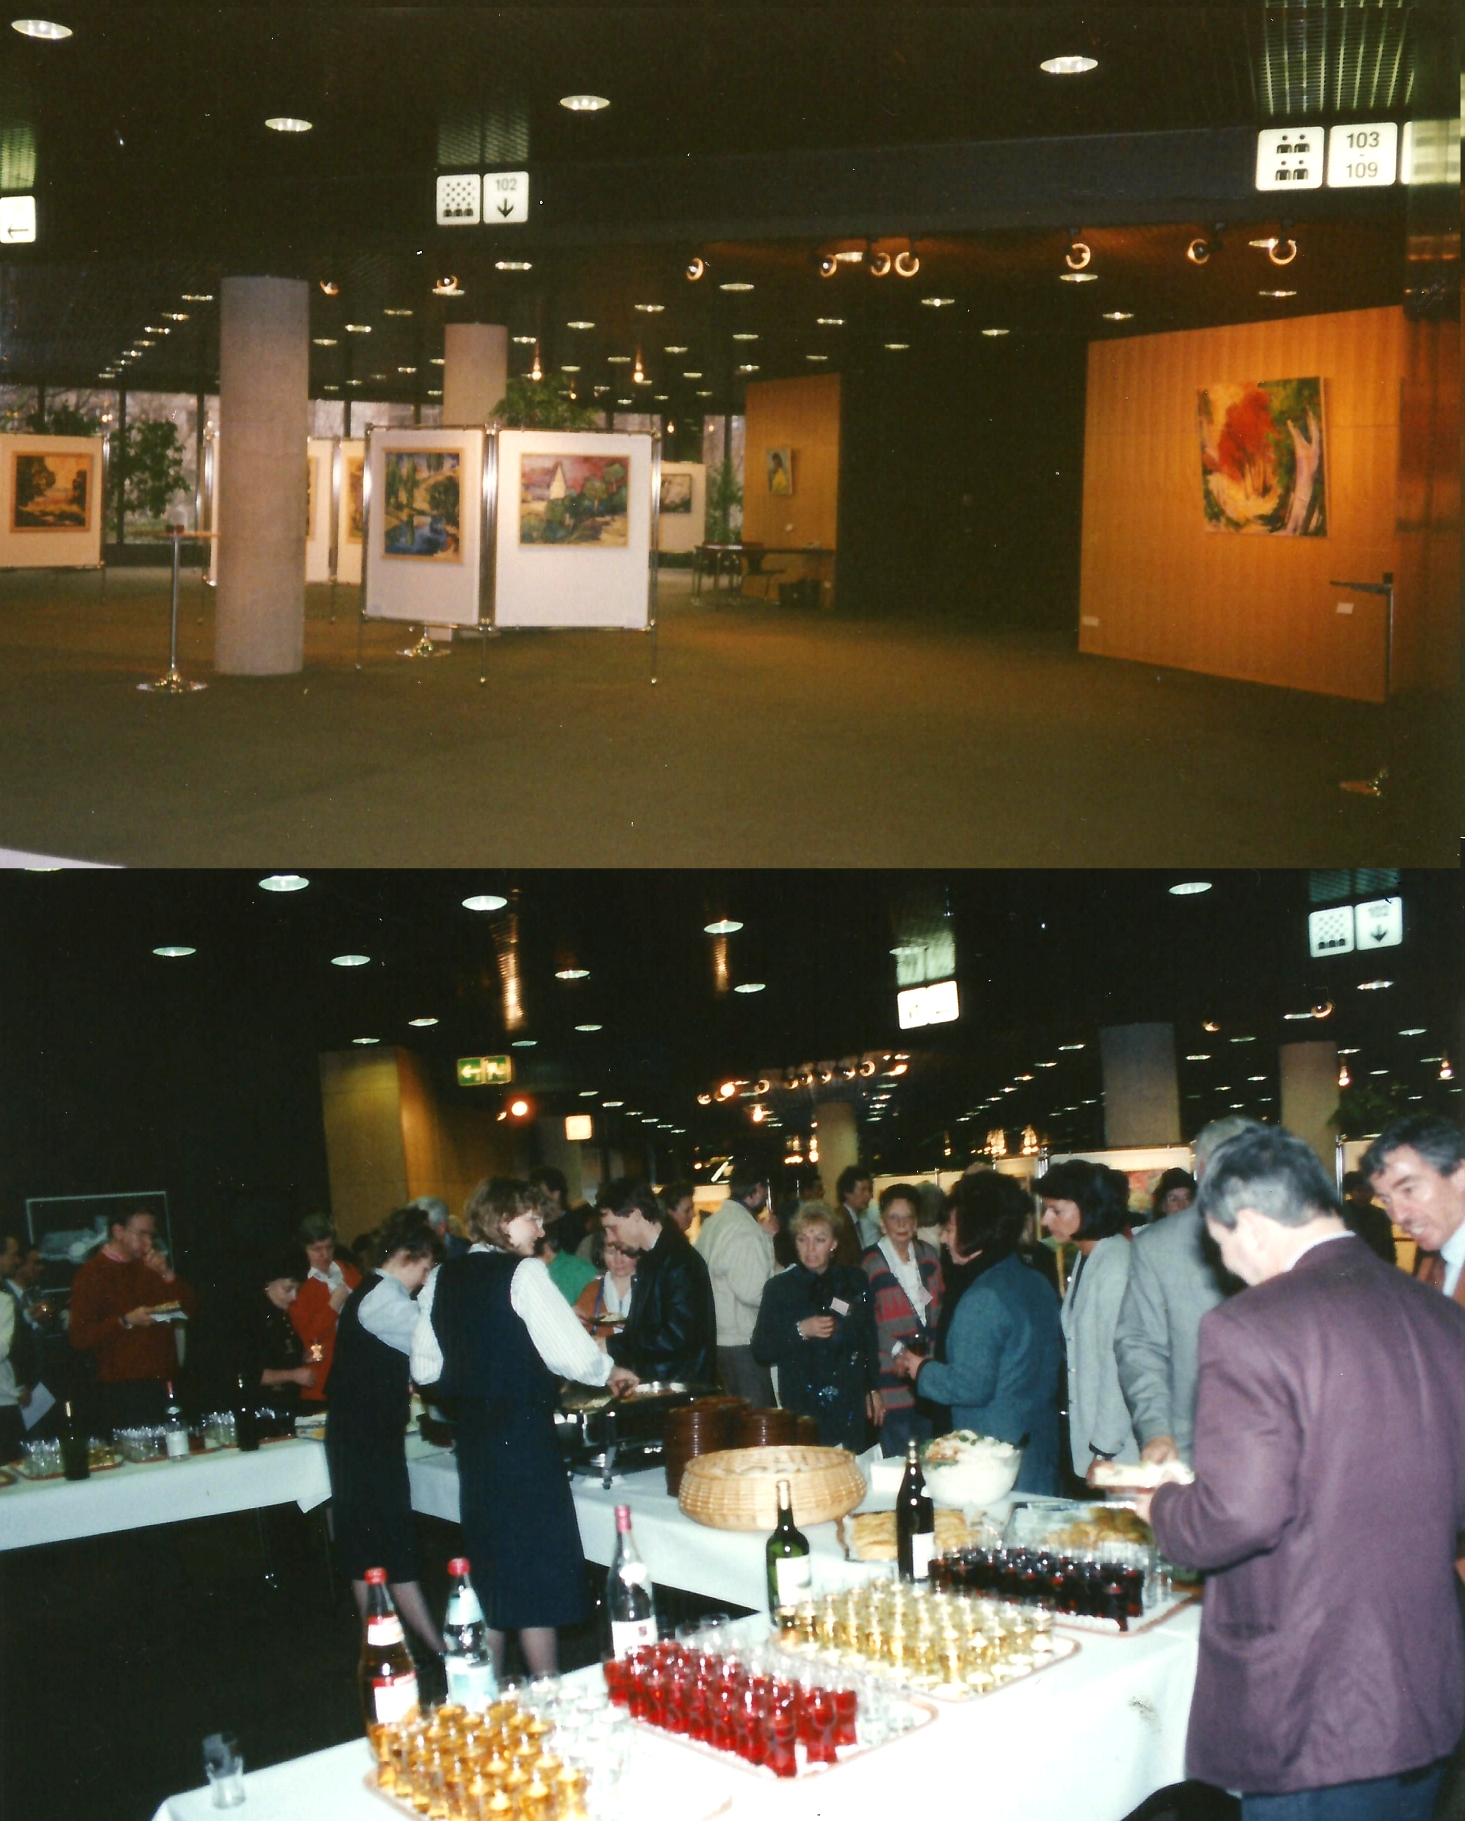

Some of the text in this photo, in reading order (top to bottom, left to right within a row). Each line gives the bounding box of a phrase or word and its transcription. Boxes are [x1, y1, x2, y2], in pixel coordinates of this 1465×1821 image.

[1346, 131, 1380, 149] 103
[1346, 161, 1378, 179] 109
[496, 177, 517, 191] 102
